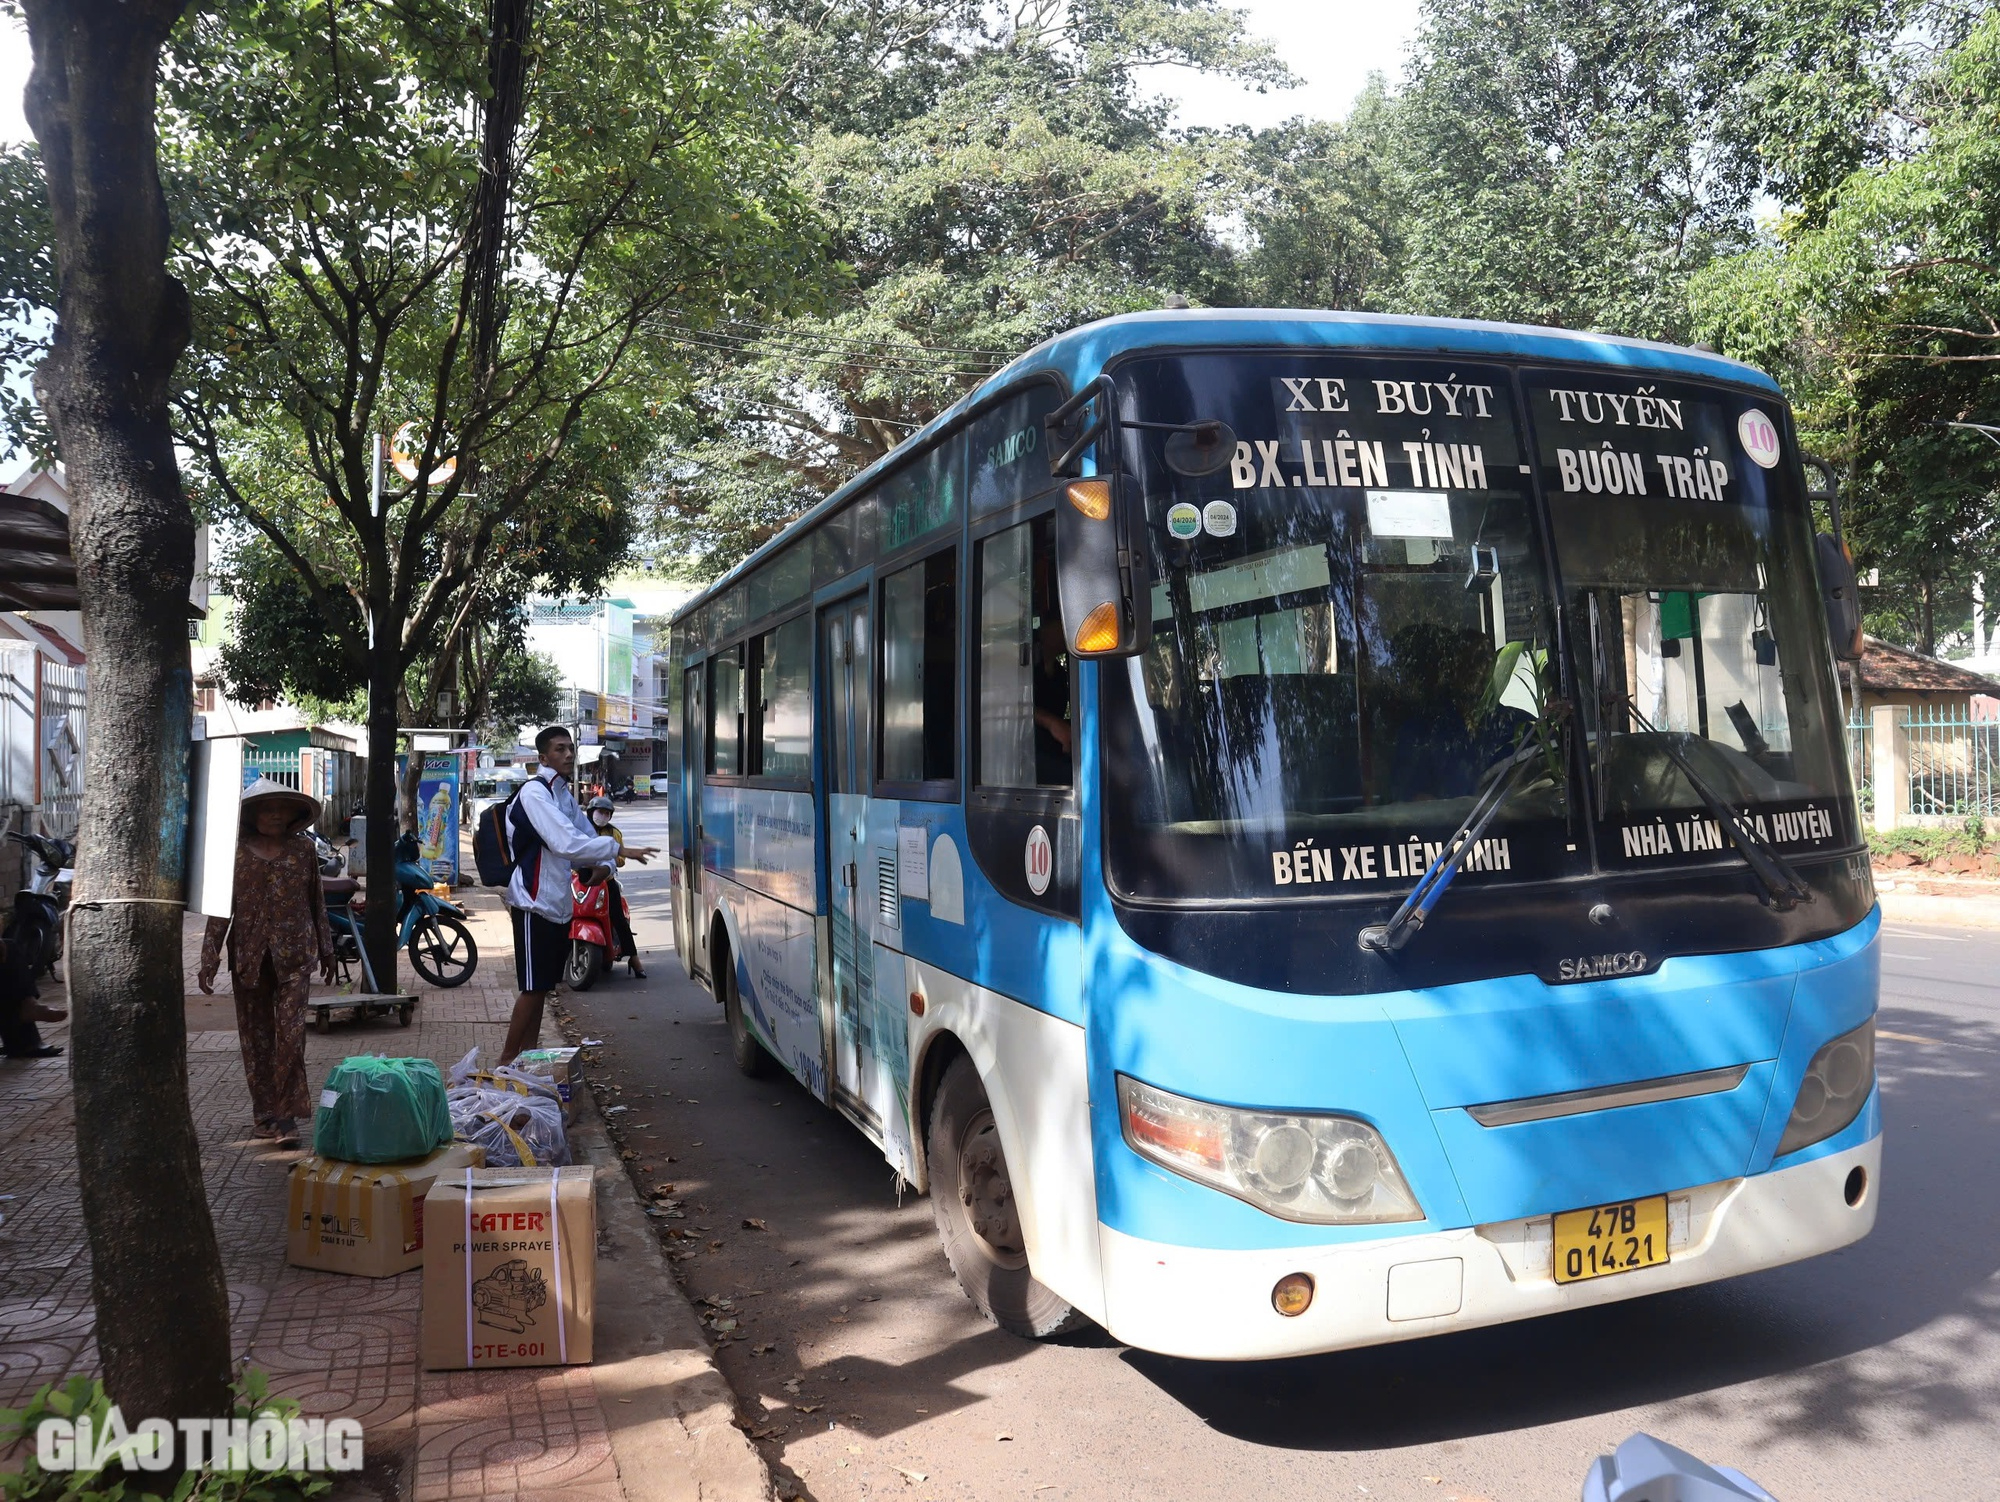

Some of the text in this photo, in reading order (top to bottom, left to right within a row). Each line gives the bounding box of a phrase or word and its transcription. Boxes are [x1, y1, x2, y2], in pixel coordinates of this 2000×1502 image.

[1280, 372, 1684, 431] XE BUÝT TUYẾN
[987, 425, 1037, 468] SAMCO
[1744, 420, 1775, 453] 10
[1402, 427, 1488, 490] TỈNH
[1556, 440, 1647, 496] BUÔN
[1656, 445, 1729, 502] TRẤP
[1172, 516, 1197, 524] 04/2024
[1029, 841, 1049, 877] 10
[1272, 838, 1334, 885] BẾN
[1339, 845, 1378, 881] XE
[1382, 835, 1446, 878] LIÊN
[1621, 816, 1674, 858] NHÀ
[1675, 814, 1723, 852] VĂN
[1771, 803, 1833, 845] HUYỆN
[1559, 950, 1647, 980] SAMCO
[1587, 1204, 1637, 1240] 47B
[502, 1240, 560, 1252] SPRAYE
[1566, 1233, 1654, 1278] 014.21
